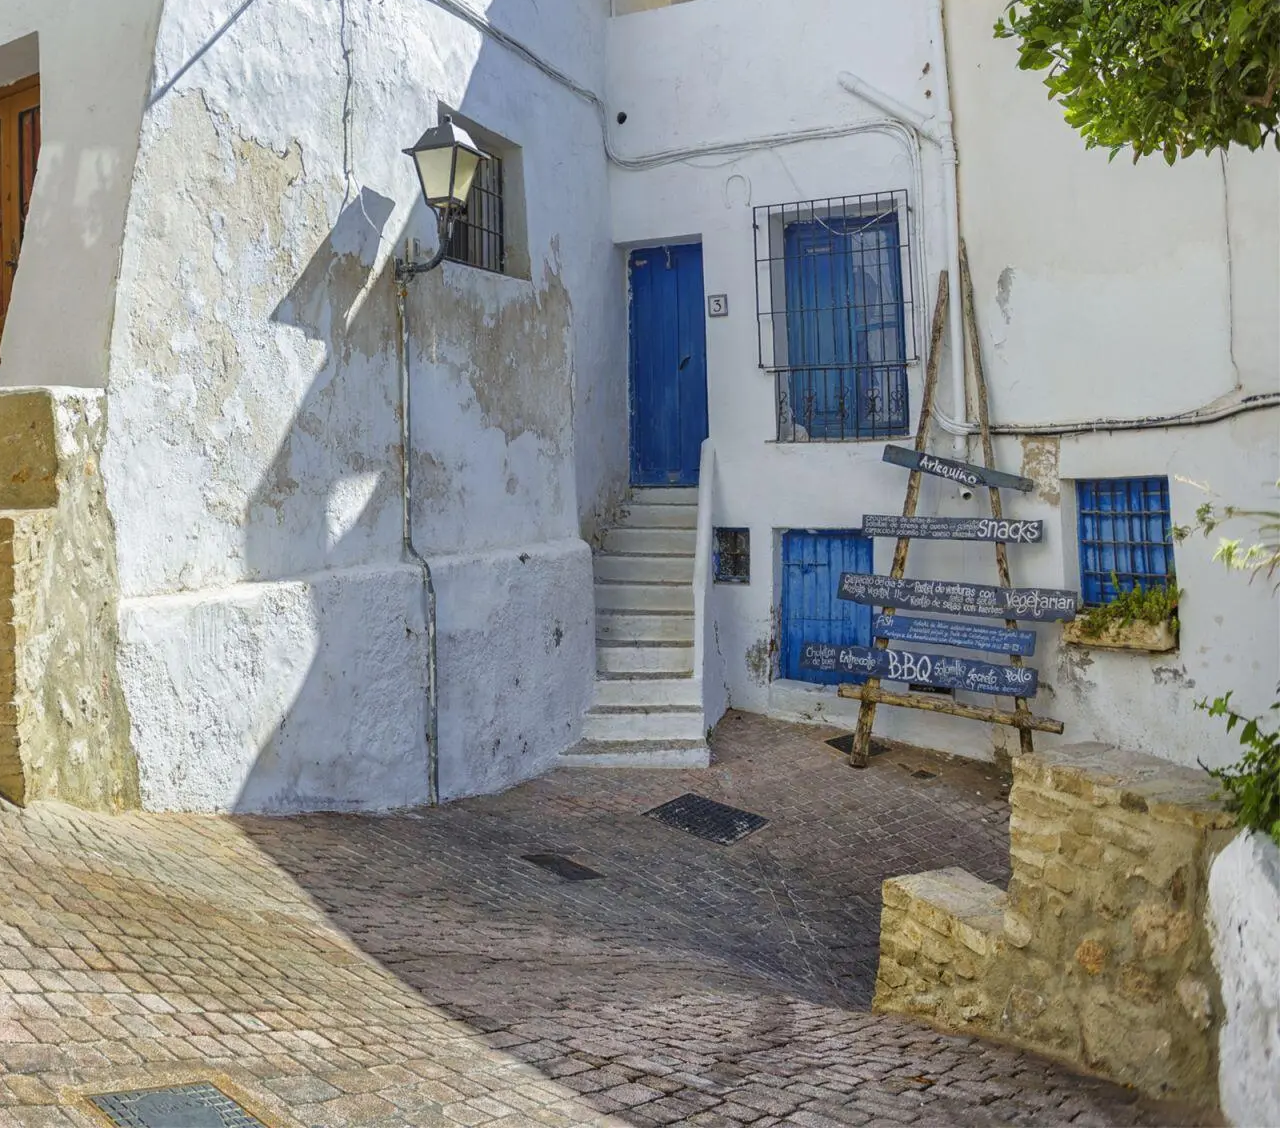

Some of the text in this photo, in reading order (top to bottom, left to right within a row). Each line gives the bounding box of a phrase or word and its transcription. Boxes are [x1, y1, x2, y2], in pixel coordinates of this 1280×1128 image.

[713, 299, 721, 312] 3
[920, 455, 977, 484] Arlequino
[1005, 590, 1074, 617] Vegetarian
[1004, 666, 1033, 683] Pollo
